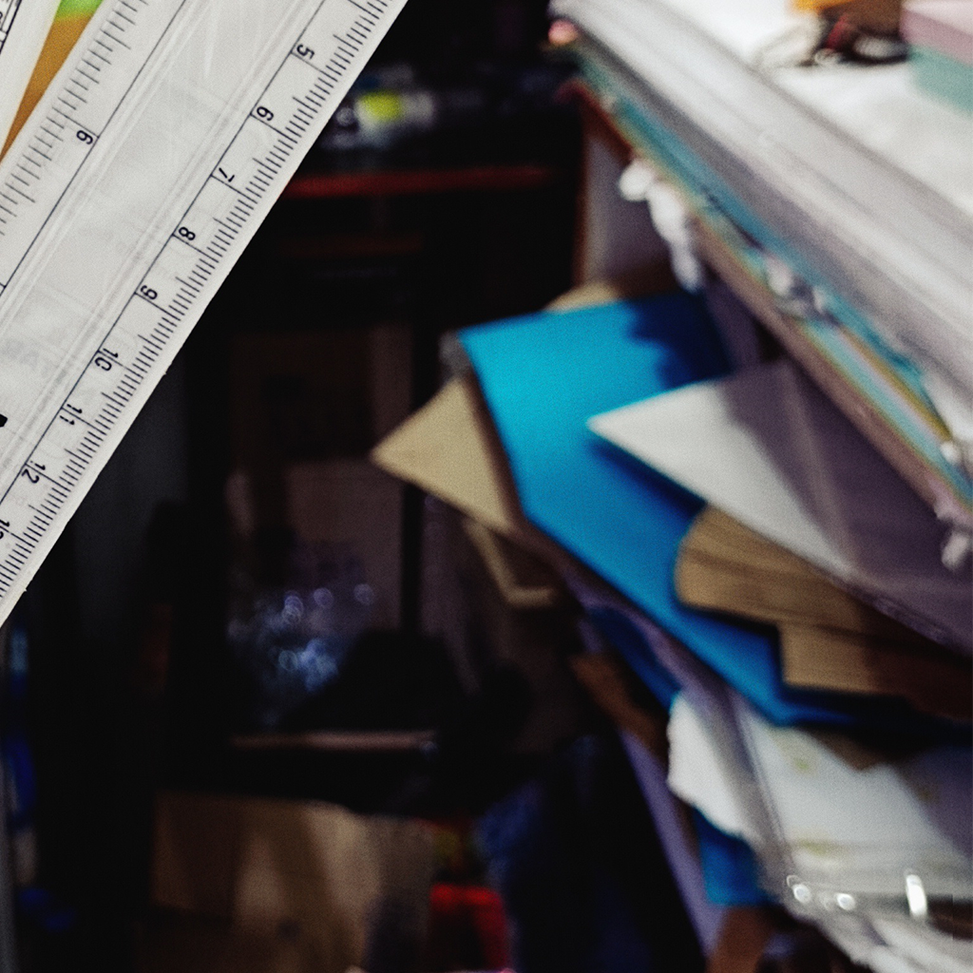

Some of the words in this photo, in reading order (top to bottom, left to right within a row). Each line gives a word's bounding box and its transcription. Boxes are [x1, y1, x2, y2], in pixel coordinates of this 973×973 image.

[297, 44, 315, 59] 5
[256, 106, 274, 121] 6
[76, 130, 93, 145] 9
[219, 167, 235, 183] 7
[178, 226, 196, 241] 8
[140, 285, 158, 300] 9
[94, 347, 119, 371] 10
[59, 403, 83, 425] 11
[21, 460, 46, 484] 12
